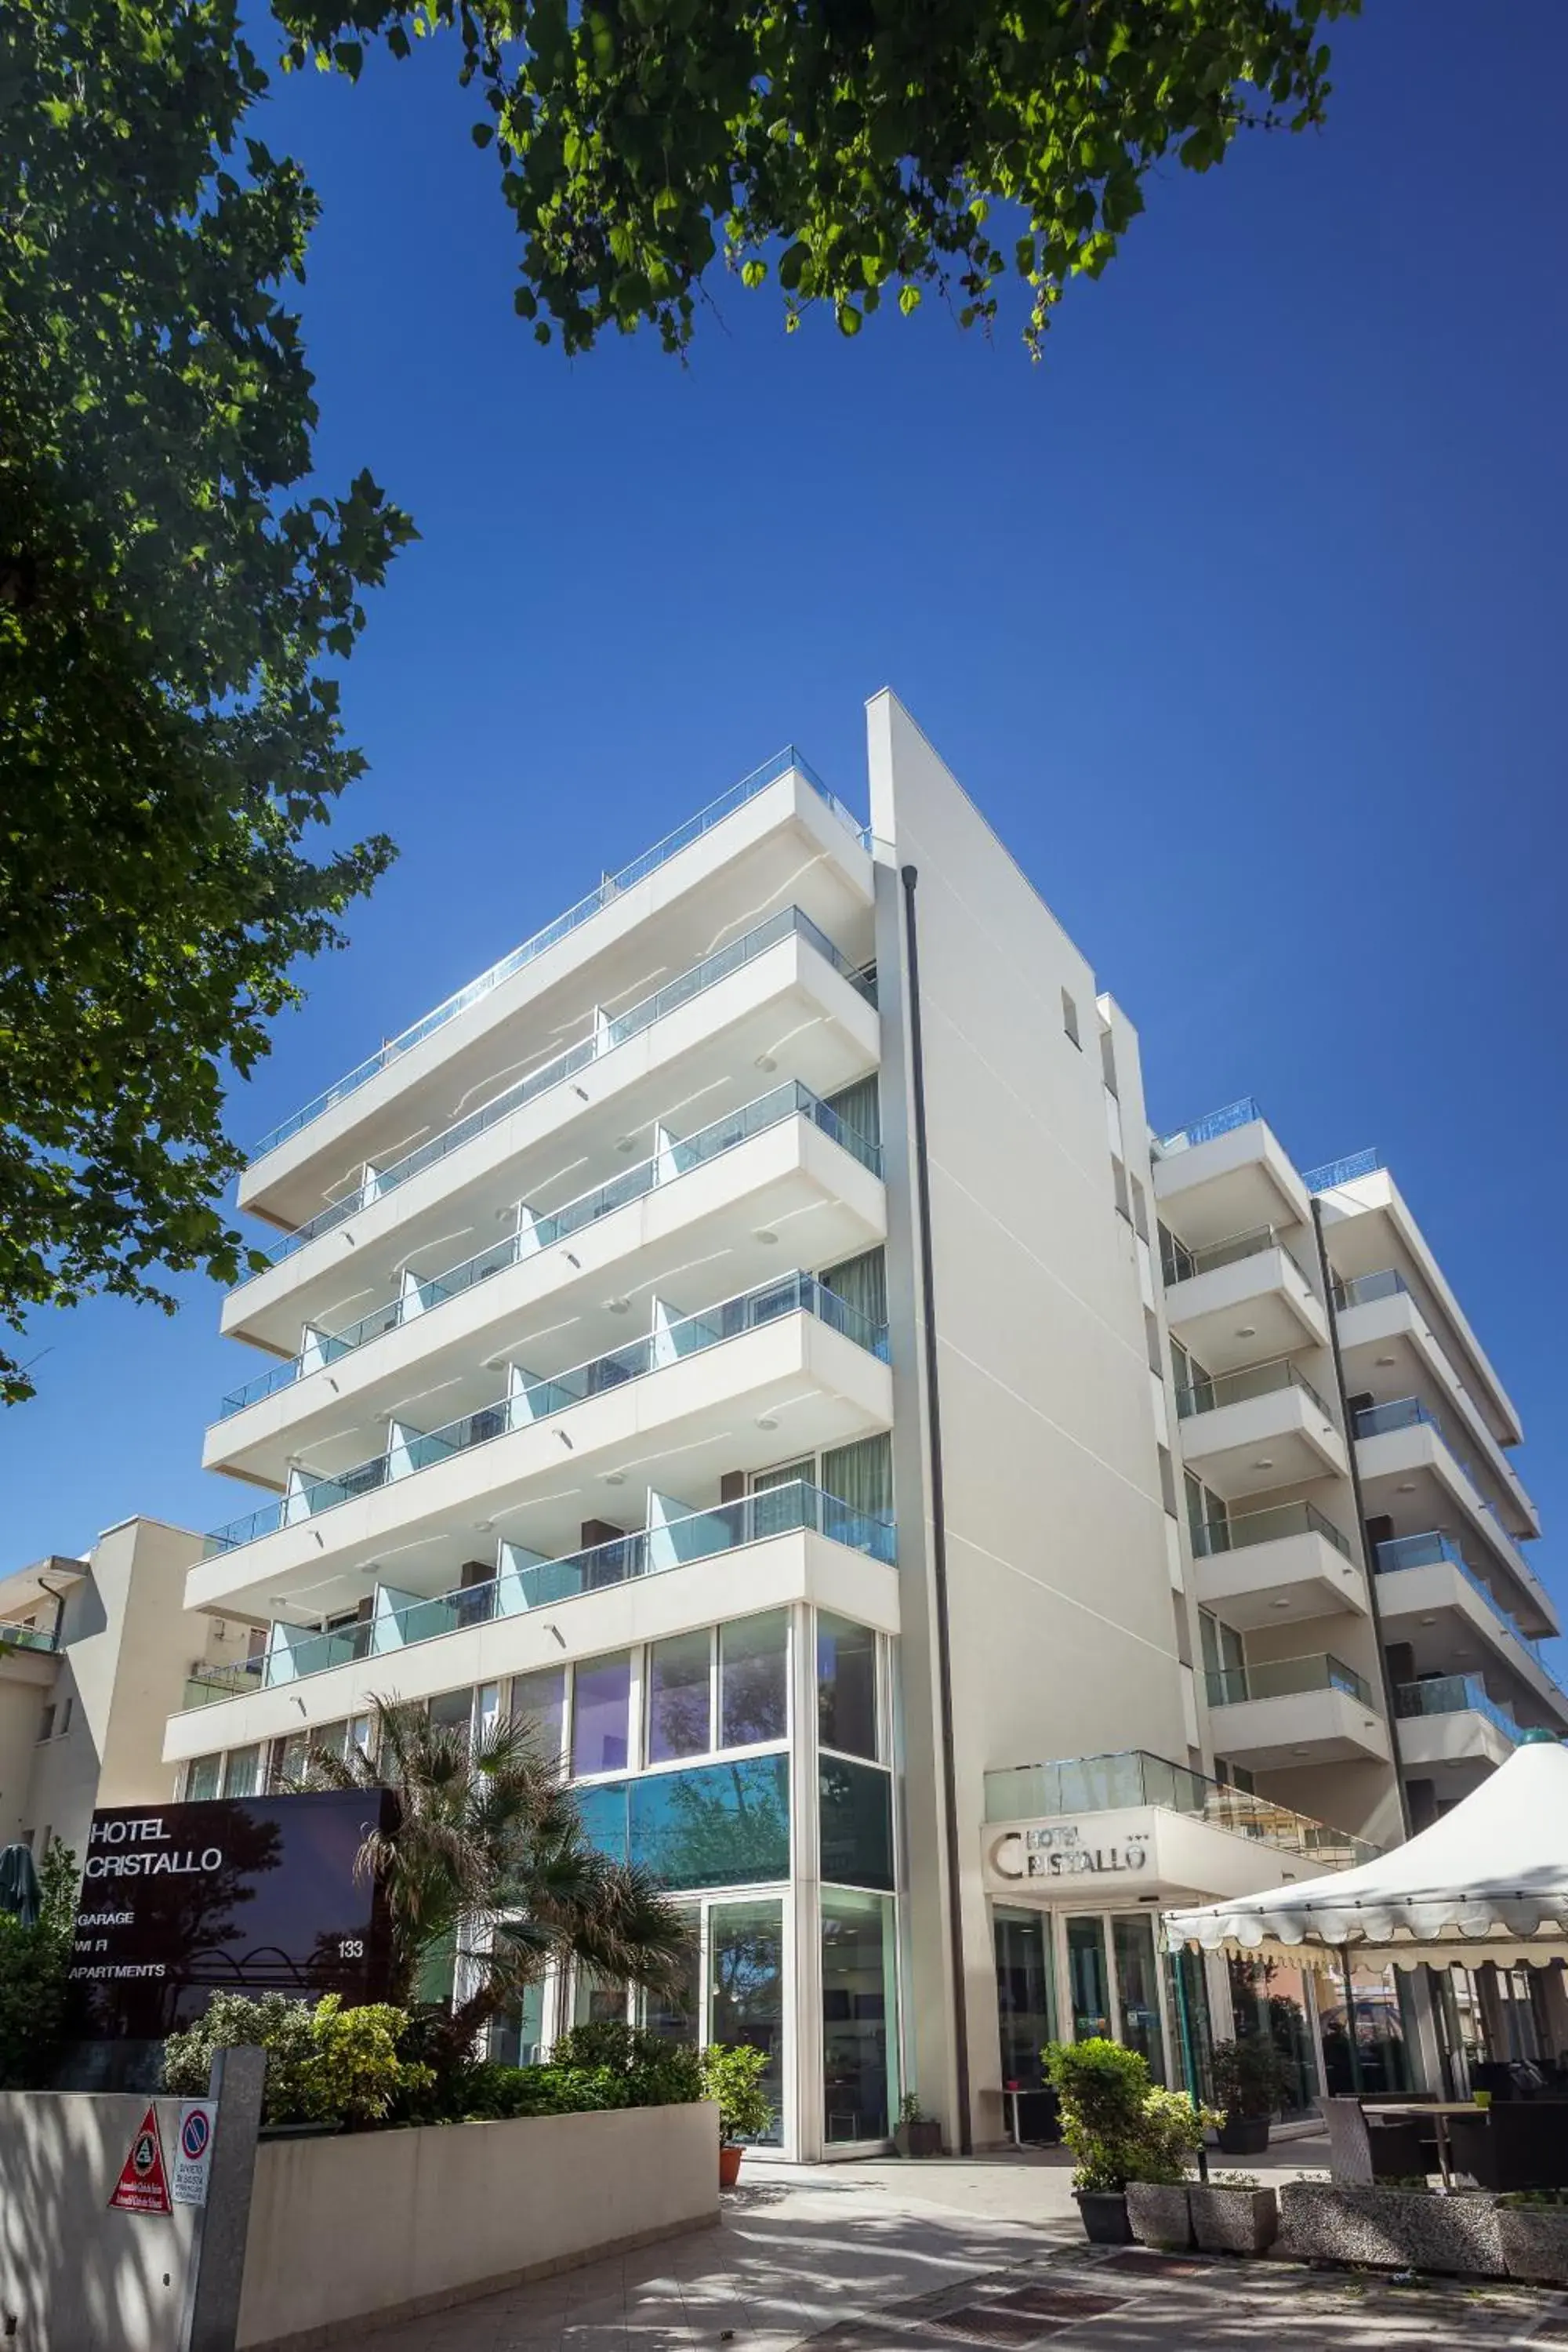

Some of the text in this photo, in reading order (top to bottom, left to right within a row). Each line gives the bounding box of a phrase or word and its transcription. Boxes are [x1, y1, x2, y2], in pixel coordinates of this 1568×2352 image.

[90, 1819, 171, 1843] HOTEL
[1026, 1826, 1083, 1850] HOTEL
[86, 1848, 222, 1878] CRISTALLO
[78, 1912, 135, 1926] GARAGE
[74, 1939, 107, 1951] WI FI
[339, 1940, 363, 1958] 133
[68, 1964, 165, 1979] APARTMENTS
